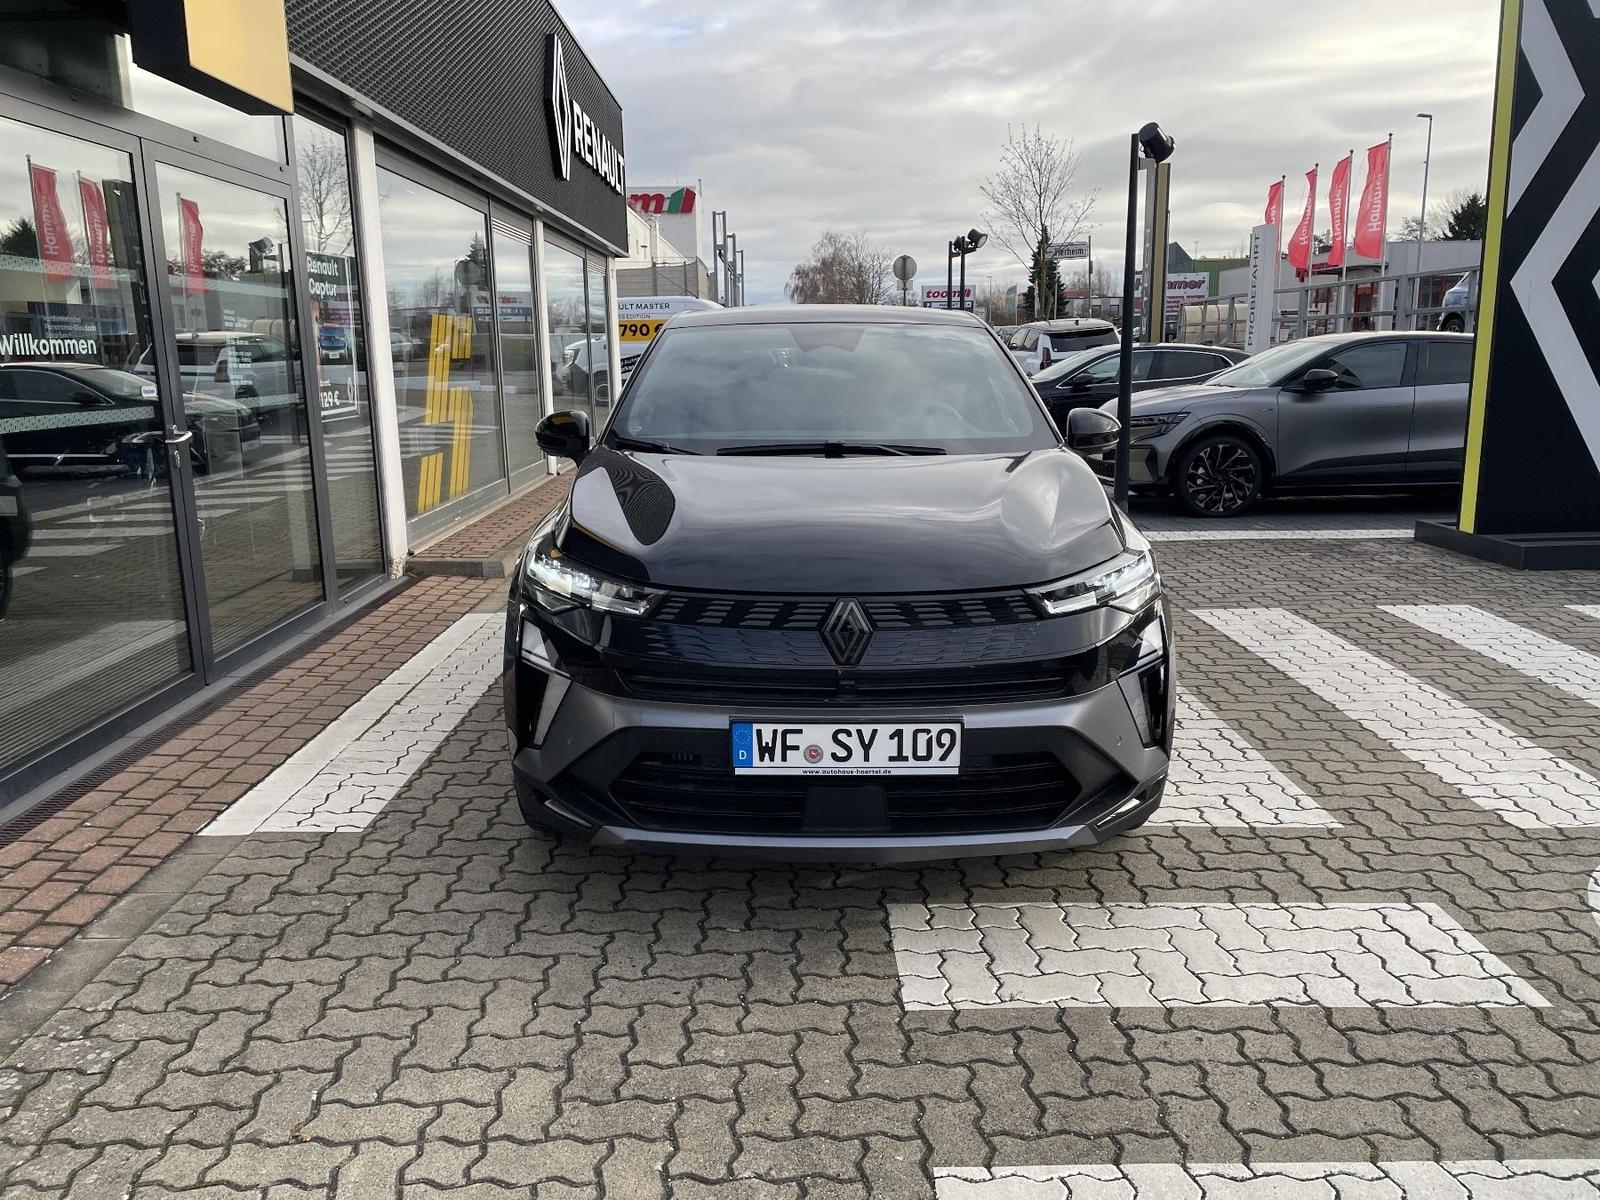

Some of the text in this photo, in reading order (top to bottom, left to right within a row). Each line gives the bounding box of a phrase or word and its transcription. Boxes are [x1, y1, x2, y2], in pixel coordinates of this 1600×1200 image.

[573, 99, 625, 196] RENAULT
[306, 255, 339, 277] Renault
[308, 277, 337, 300] Captur
[1247, 232, 1260, 346] PROBEFAHRT
[635, 302, 671, 310] MASTER
[619, 323, 650, 337] 790
[0, 333, 97, 356] Willkommen
[738, 751, 746, 760] D
[755, 728, 957, 763] WF SY 109
